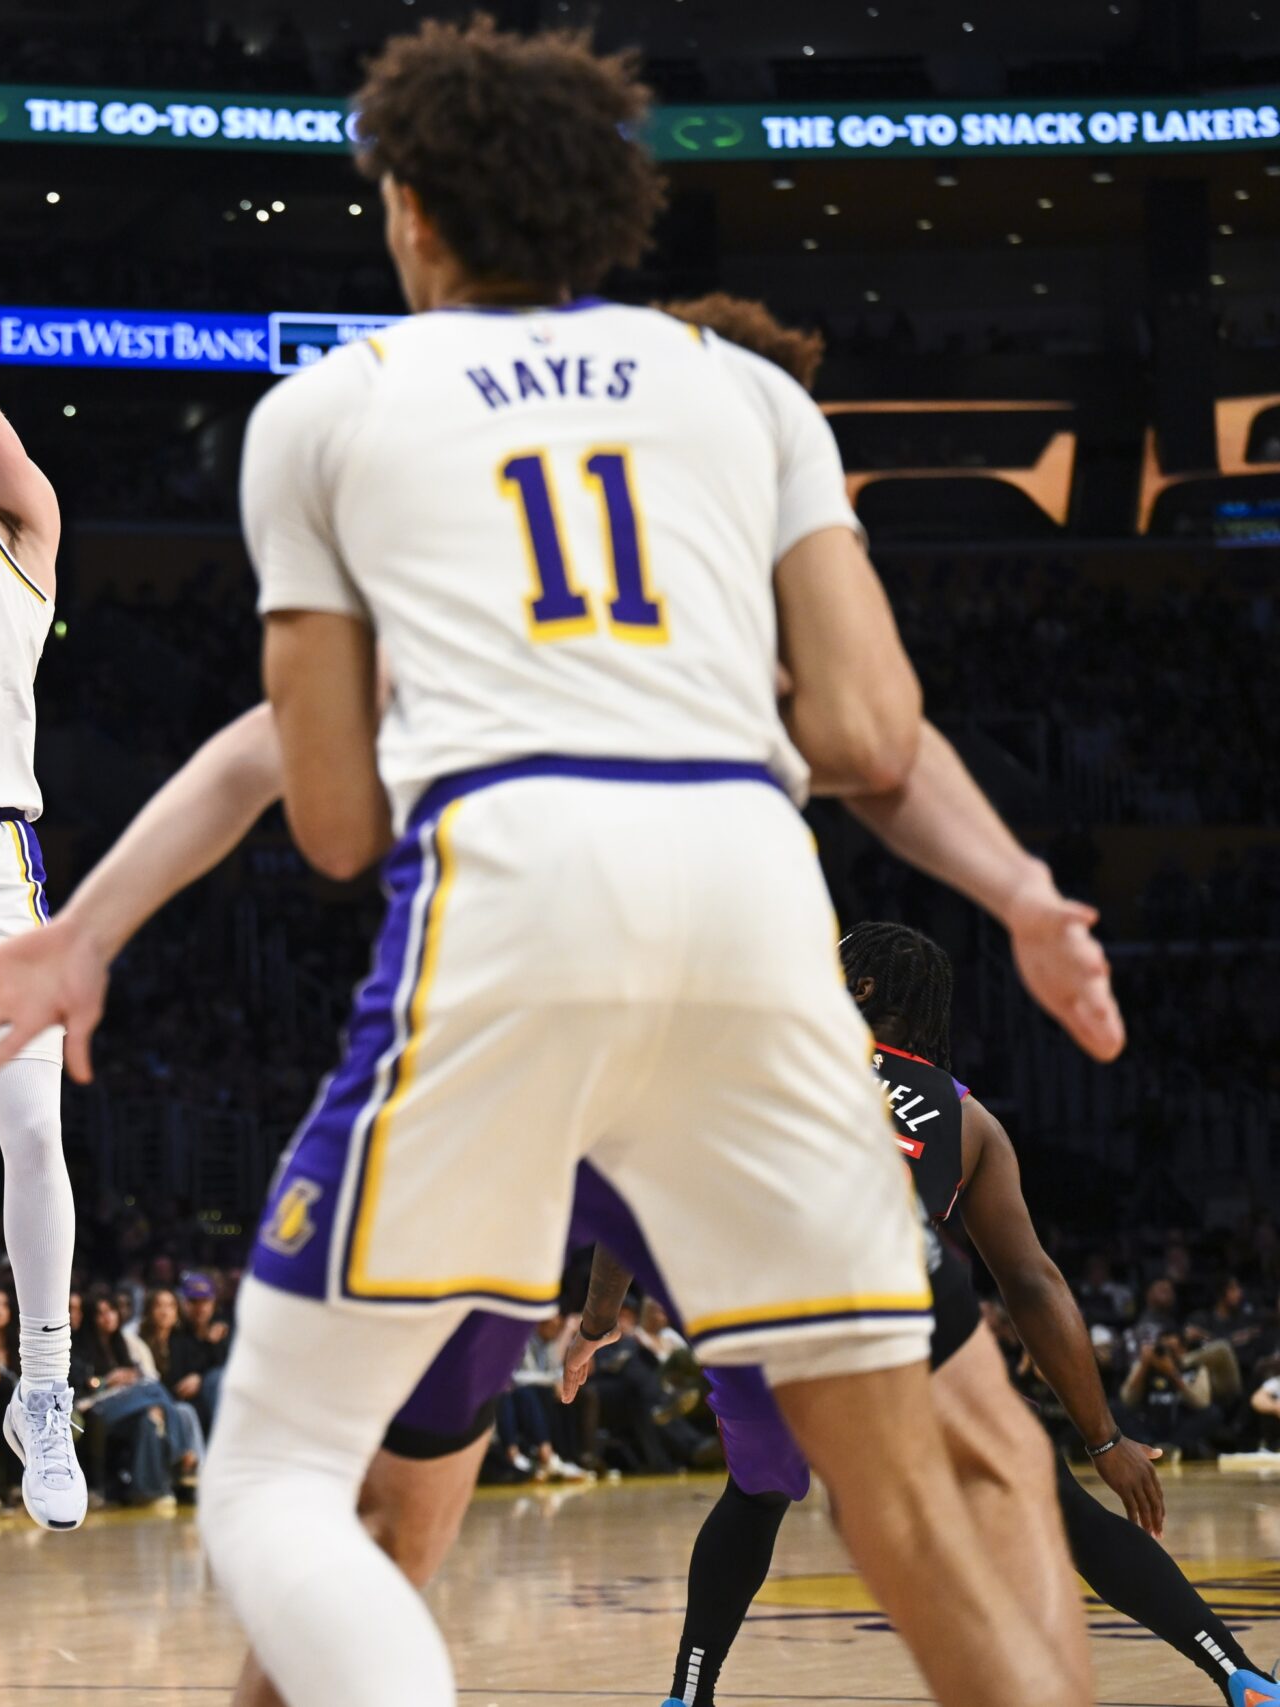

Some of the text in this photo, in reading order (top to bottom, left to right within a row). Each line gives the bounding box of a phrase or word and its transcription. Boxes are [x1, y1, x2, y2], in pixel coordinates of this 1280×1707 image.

[24, 98, 99, 133] THE
[100, 102, 219, 138] GO-TO
[221, 106, 344, 142] SNACK
[761, 105, 1280, 149] THE GO-TO SNACK OF LAKERS
[466, 356, 637, 410] HAYES
[497, 444, 670, 646] 11
